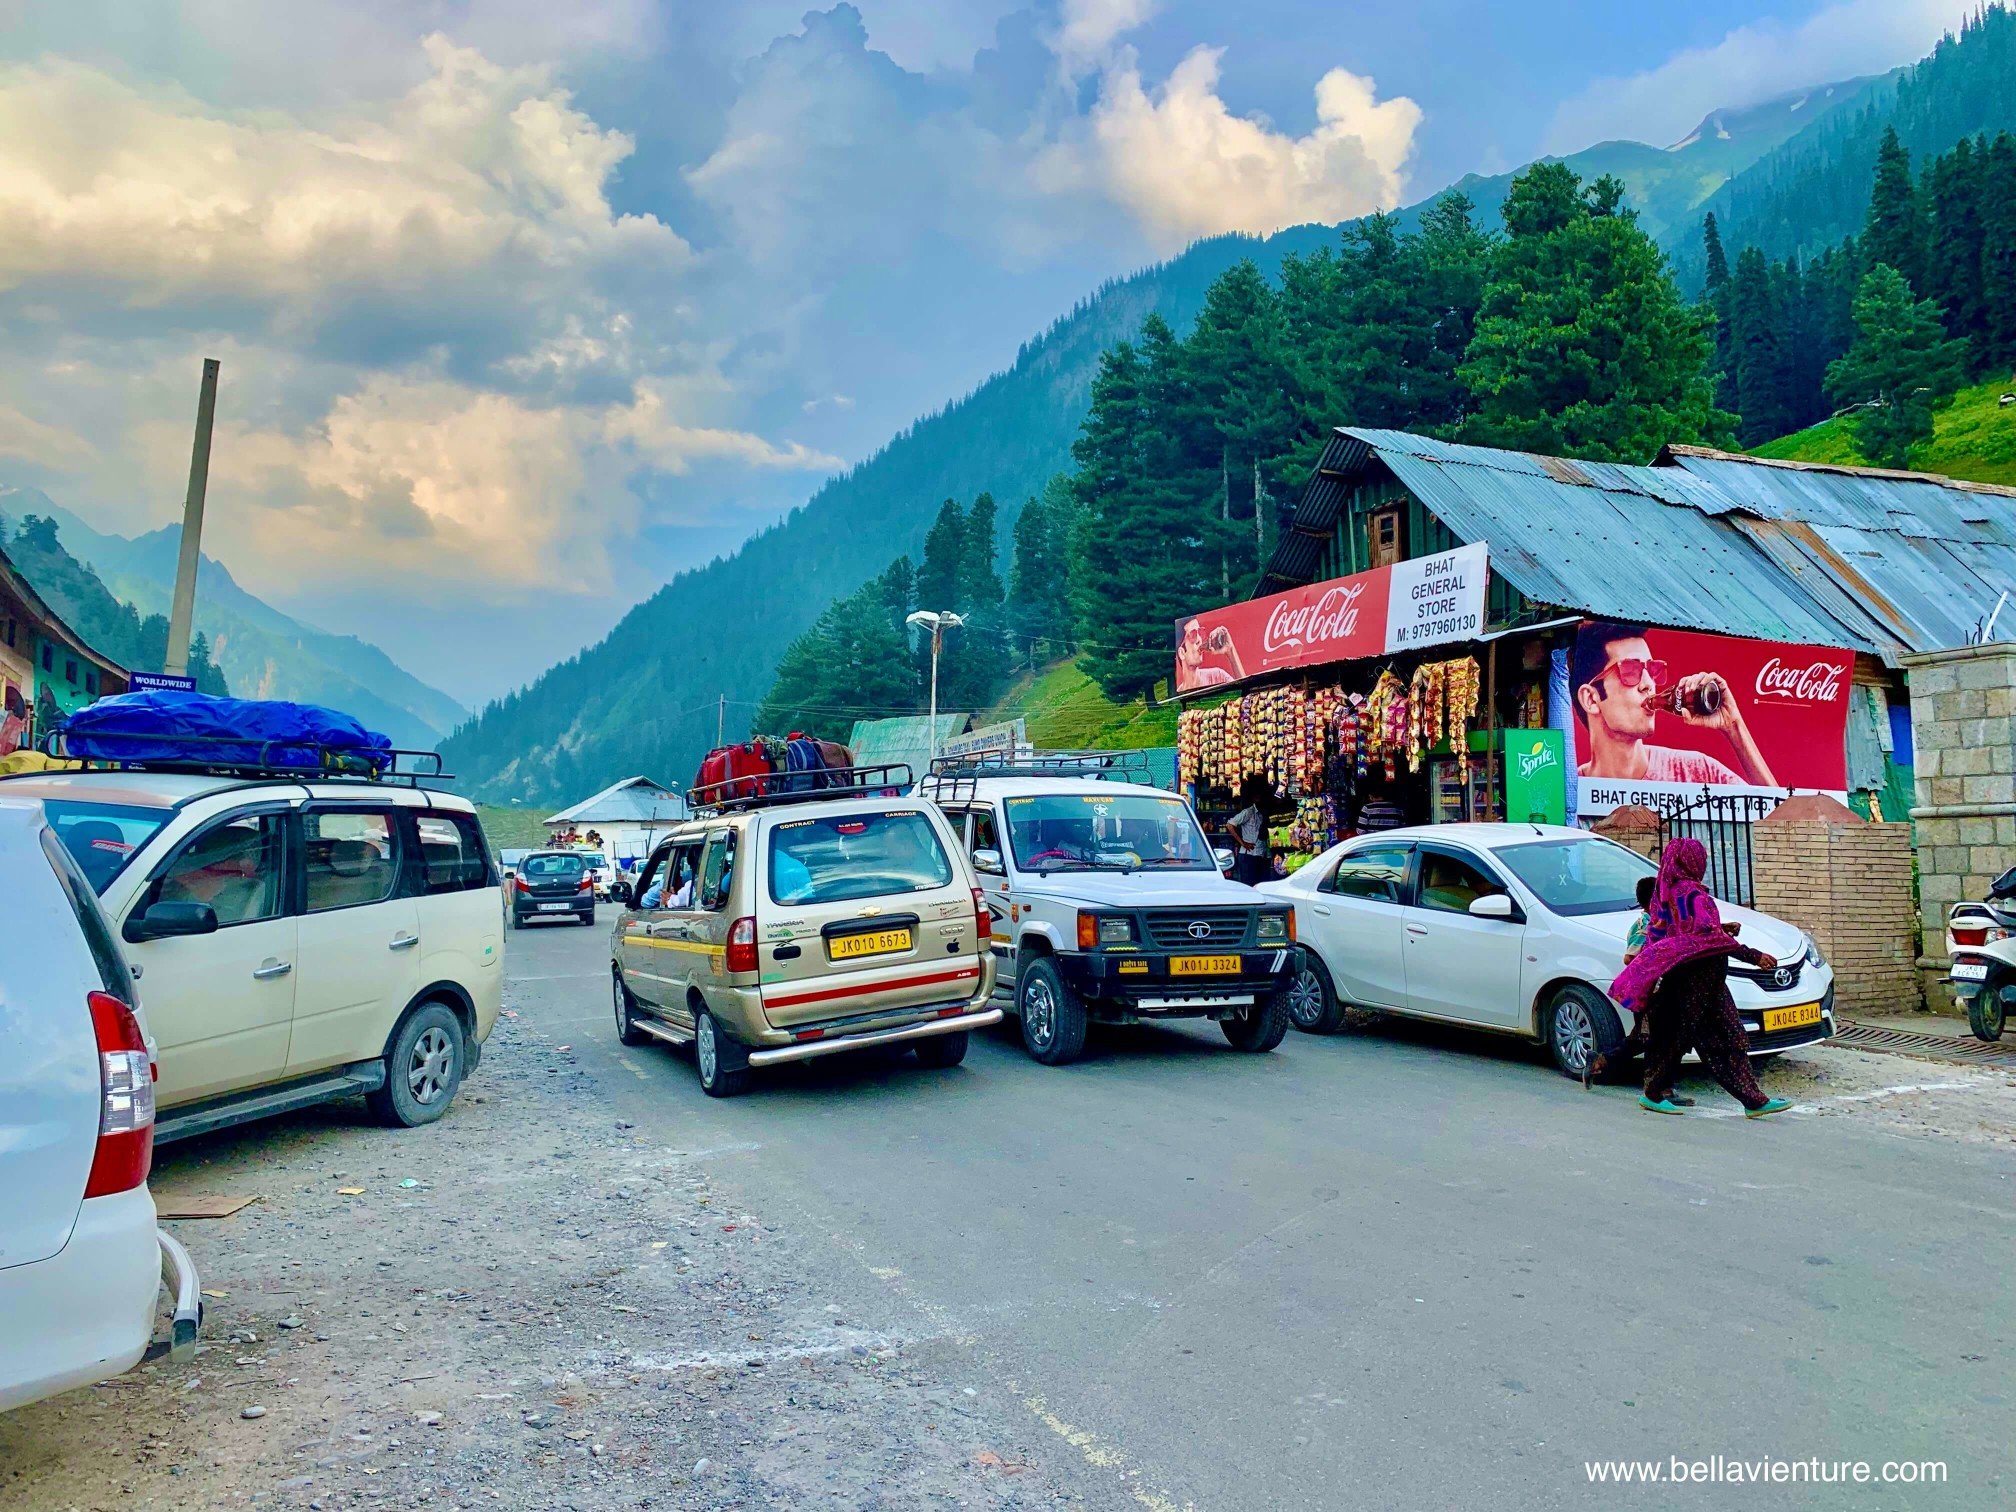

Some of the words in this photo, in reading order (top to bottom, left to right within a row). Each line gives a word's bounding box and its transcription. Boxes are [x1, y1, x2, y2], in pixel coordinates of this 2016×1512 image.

[1425, 557, 1455, 577] BHAT
[1411, 575, 1466, 600] GENERAL
[1264, 581, 1368, 652] Coca-Cola
[1418, 597, 1456, 618] STORE
[1397, 627, 1409, 642] M:
[1412, 614, 1476, 640] 9797960130
[135, 676, 192, 689] WORLDWIDE
[1755, 658, 1847, 701] Coca-Cola
[1521, 749, 1552, 776] Sprite
[1591, 789, 1626, 805] BHAT
[780, 820, 815, 830] CONTRACT
[880, 933, 907, 948] 6673
[1178, 961, 1209, 972] JK01J
[1213, 959, 1237, 971] 3324
[1772, 1011, 1797, 1027] JK04E
